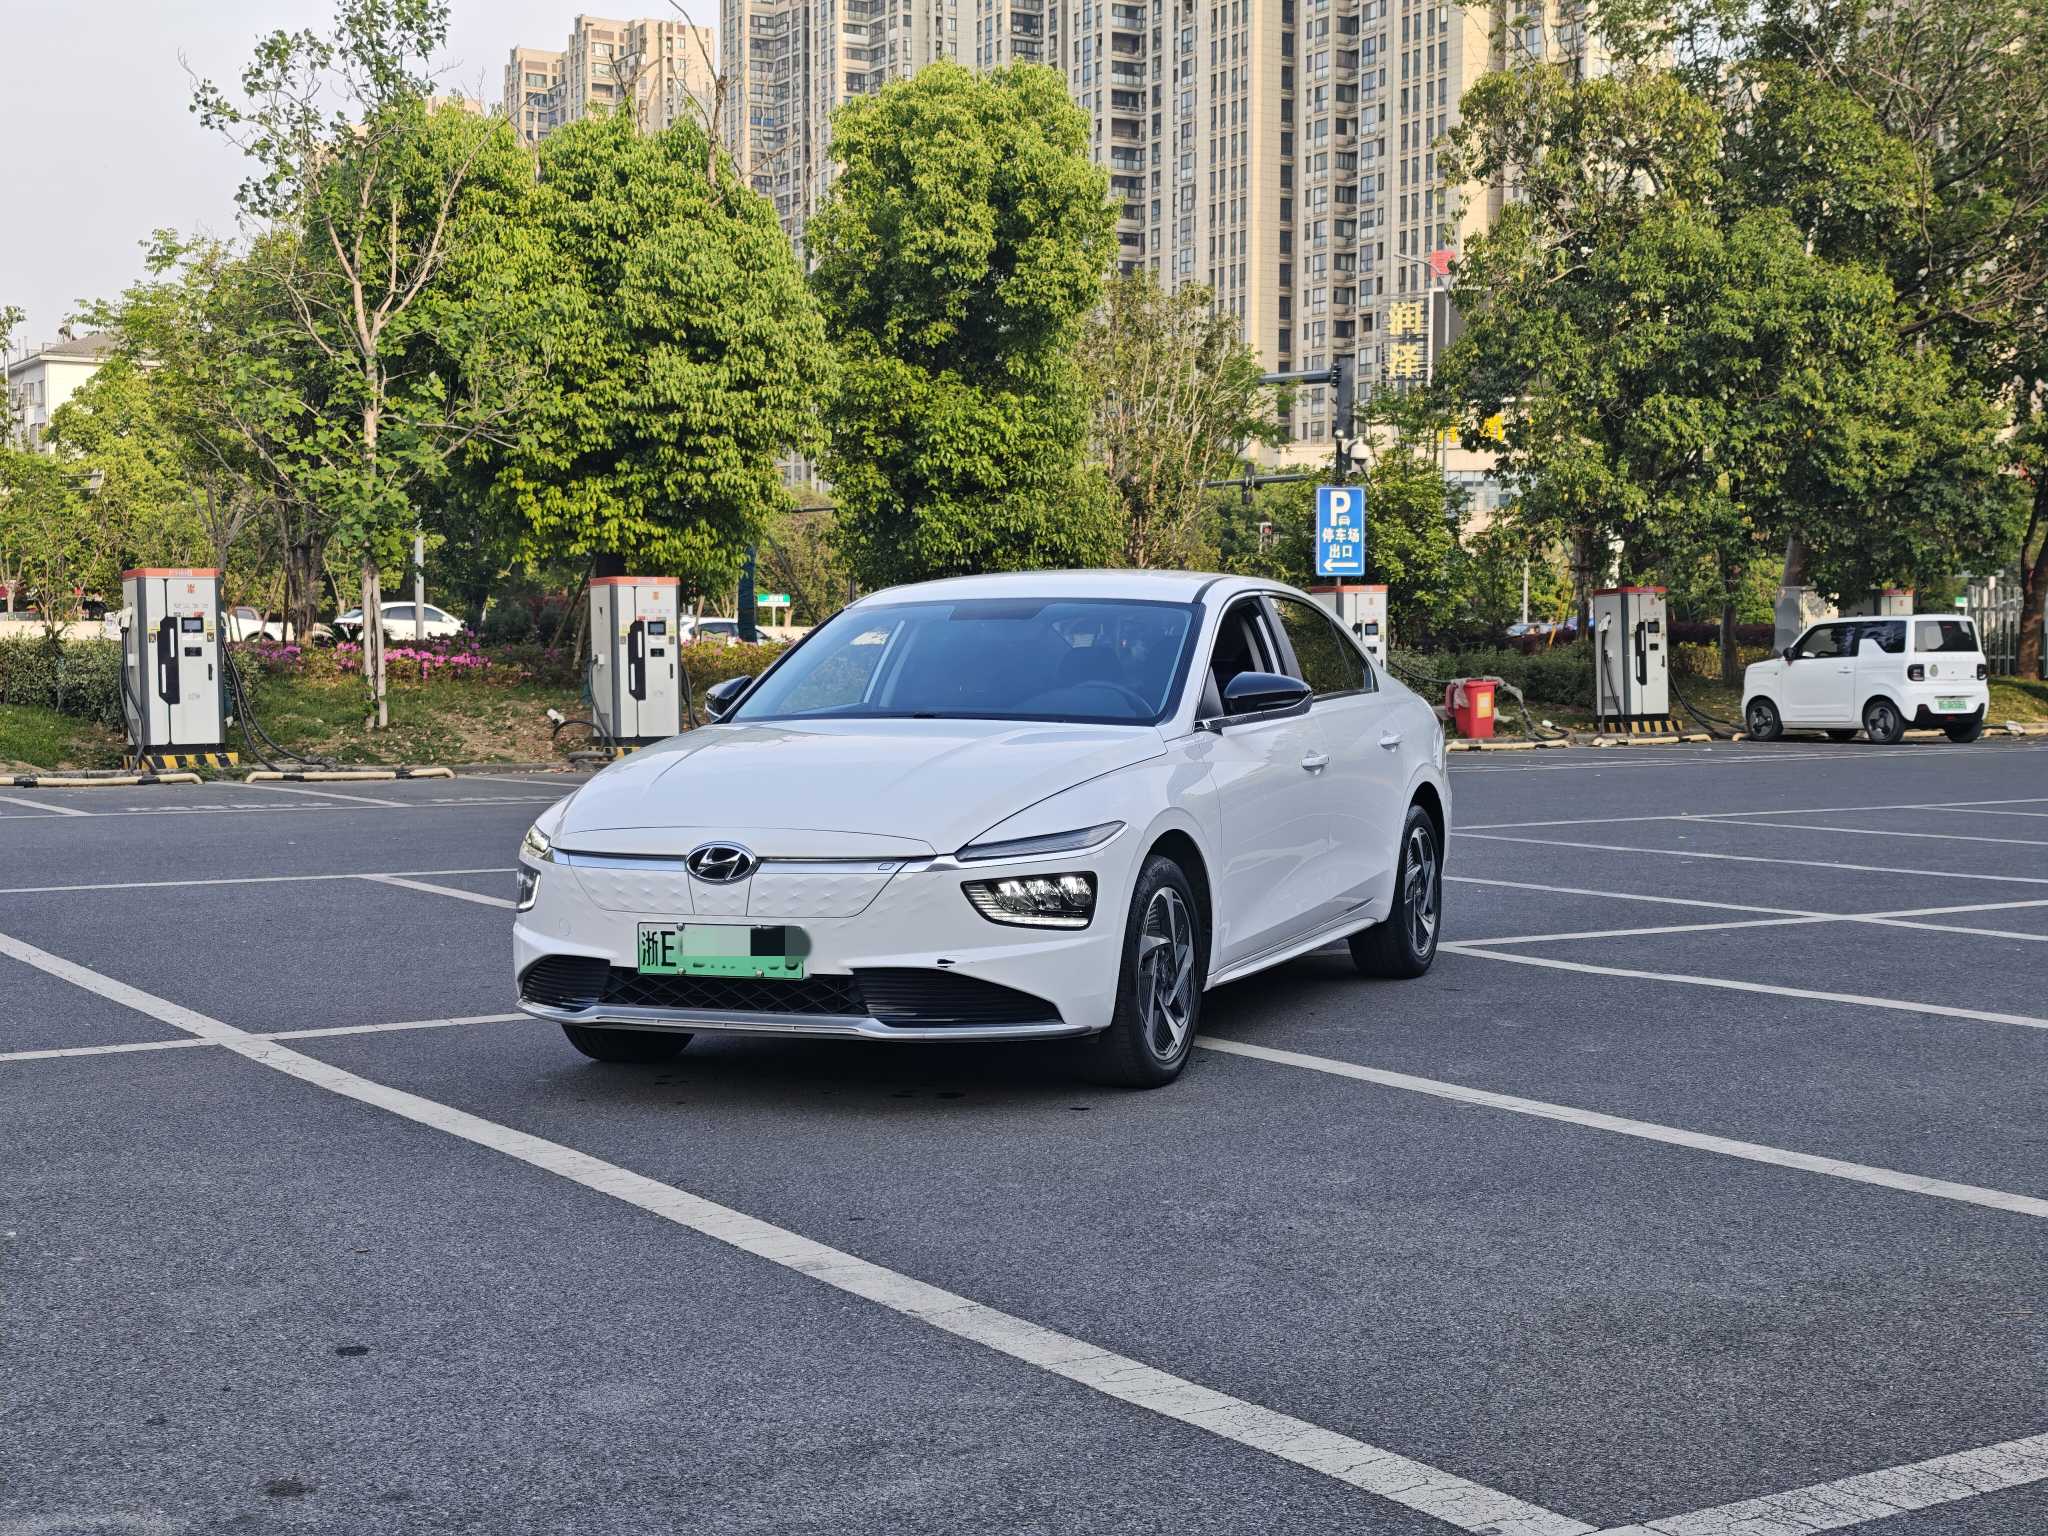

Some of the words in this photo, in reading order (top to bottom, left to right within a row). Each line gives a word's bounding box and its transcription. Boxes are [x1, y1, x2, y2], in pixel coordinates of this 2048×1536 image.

[1330, 490, 1351, 527] P
[1322, 527, 1360, 543] 停车场
[1328, 543, 1353, 559] 出口
